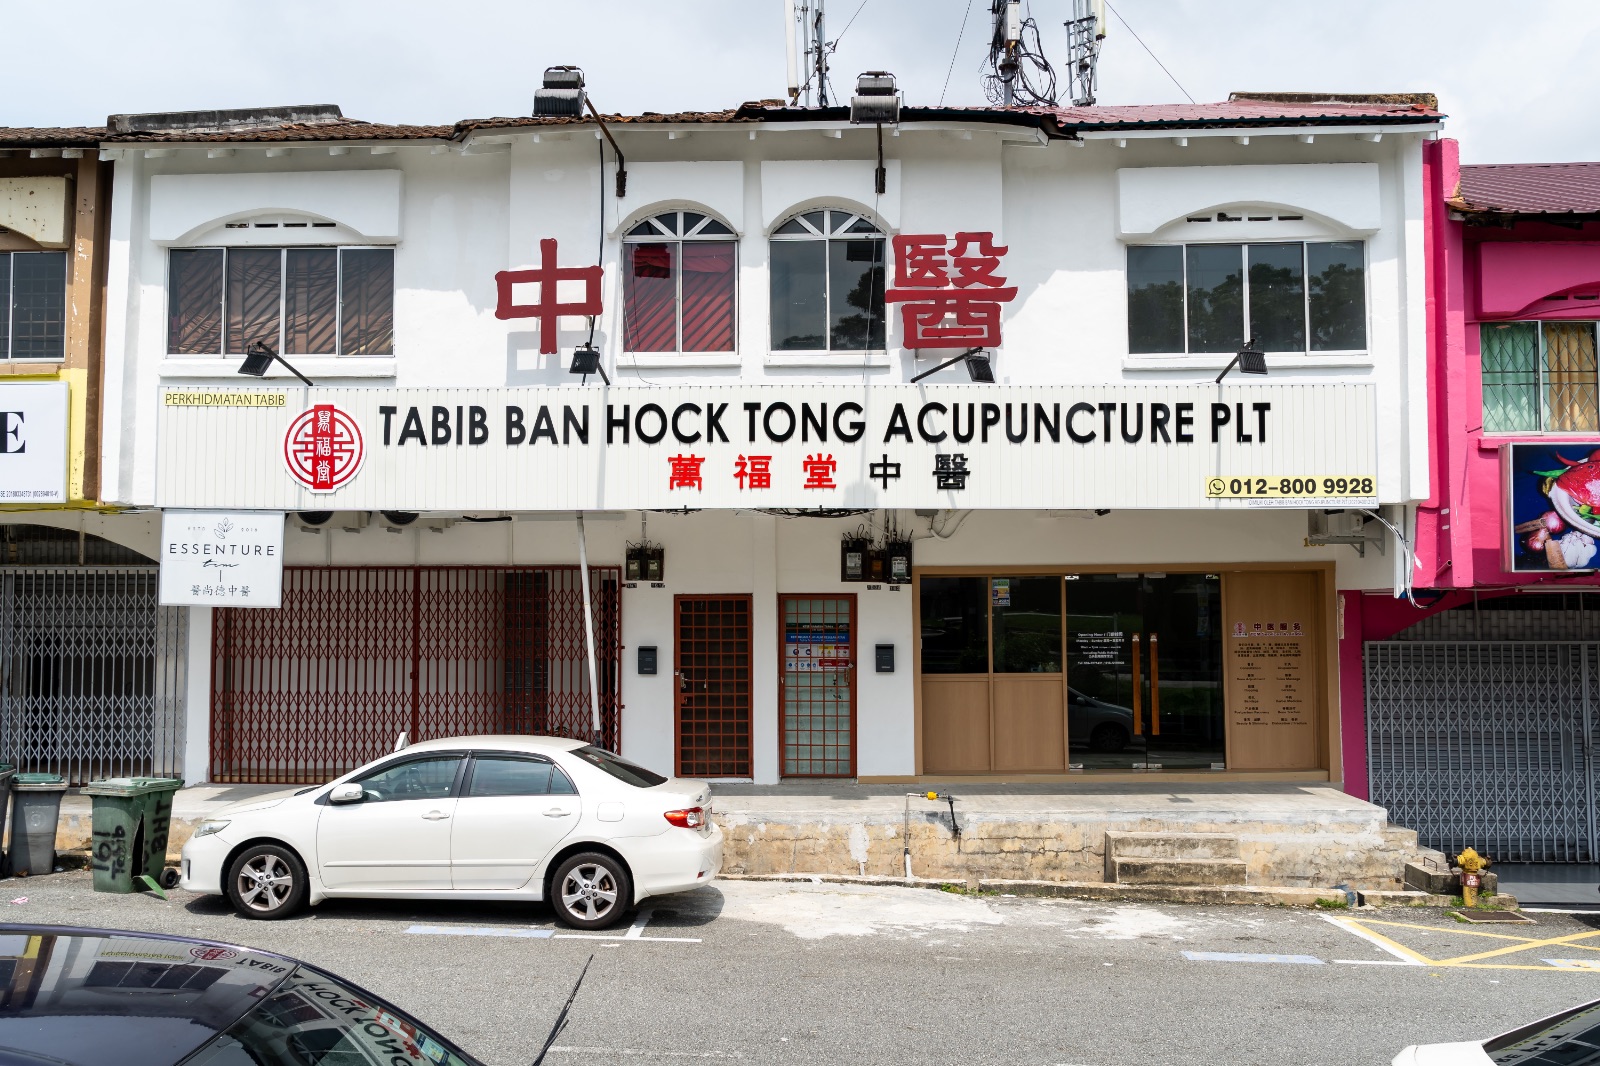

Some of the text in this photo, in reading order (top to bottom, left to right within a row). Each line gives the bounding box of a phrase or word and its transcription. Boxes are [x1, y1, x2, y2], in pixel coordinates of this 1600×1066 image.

[494, 231, 1018, 355] 中 醫
[165, 393, 285, 406] PERKHIDMATAN TABIB
[378, 401, 1271, 446] TABIB BAN HOCK TONG ACUPUNCTURE PLT
[1324, 477, 1373, 495] 9928
[169, 542, 276, 557] ESSENTURE
